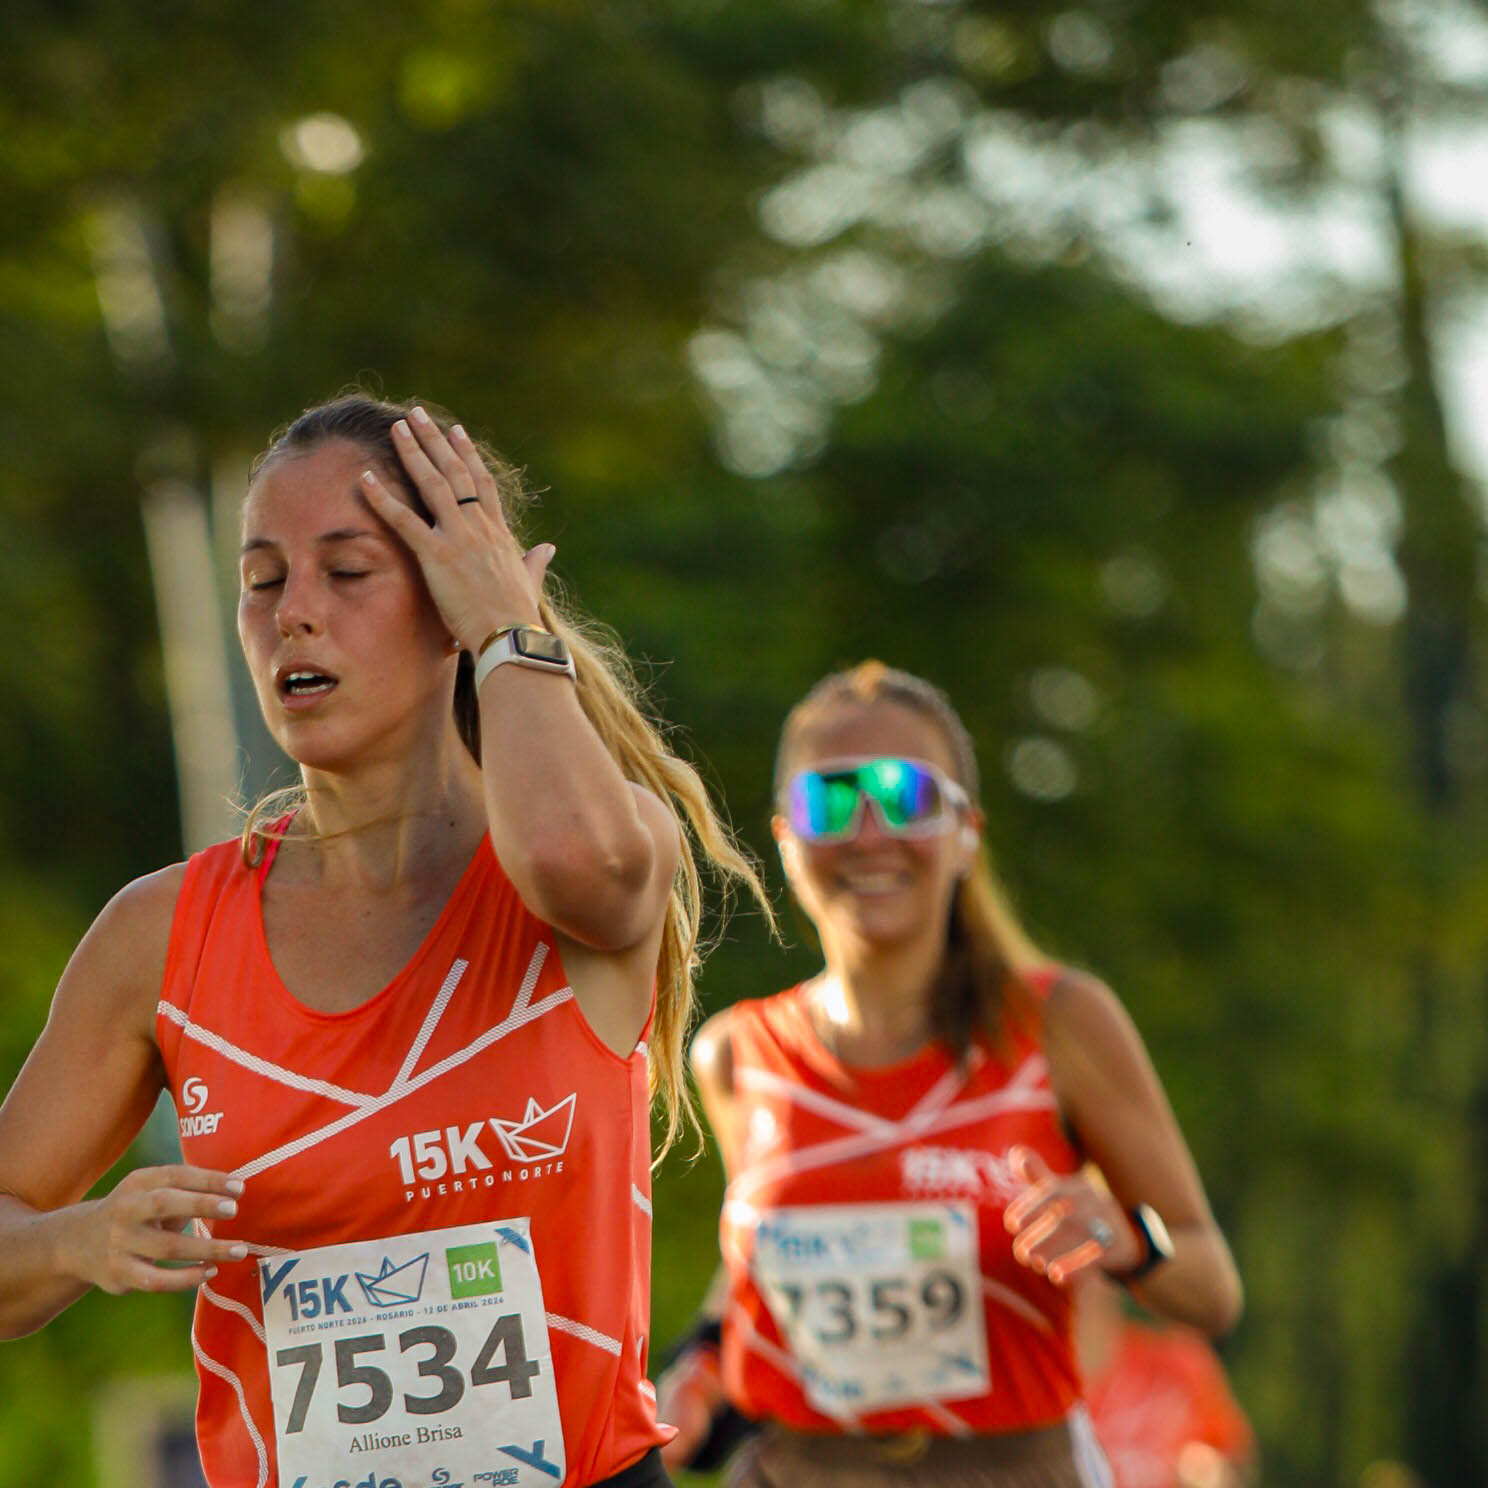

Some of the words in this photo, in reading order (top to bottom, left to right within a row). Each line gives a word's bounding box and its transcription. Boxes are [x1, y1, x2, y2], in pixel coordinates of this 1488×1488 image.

[390, 1121, 494, 1185] 15K
[405, 1175, 494, 1202] PUERTO
[503, 1161, 564, 1182] NORTE
[453, 1258, 496, 1282] 10K
[283, 1274, 354, 1321] 15K
[288, 1324, 316, 1335] PUERTO
[318, 1319, 344, 1330] NORTE
[376, 1310, 414, 1321] ROSARIO
[424, 1306, 433, 1314] 12
[437, 1304, 448, 1312] DE
[451, 1301, 479, 1311] ABRIL
[276, 1313, 540, 1435] 7534
[349, 1432, 411, 1453] Allione
[416, 1424, 463, 1444] Brisa
